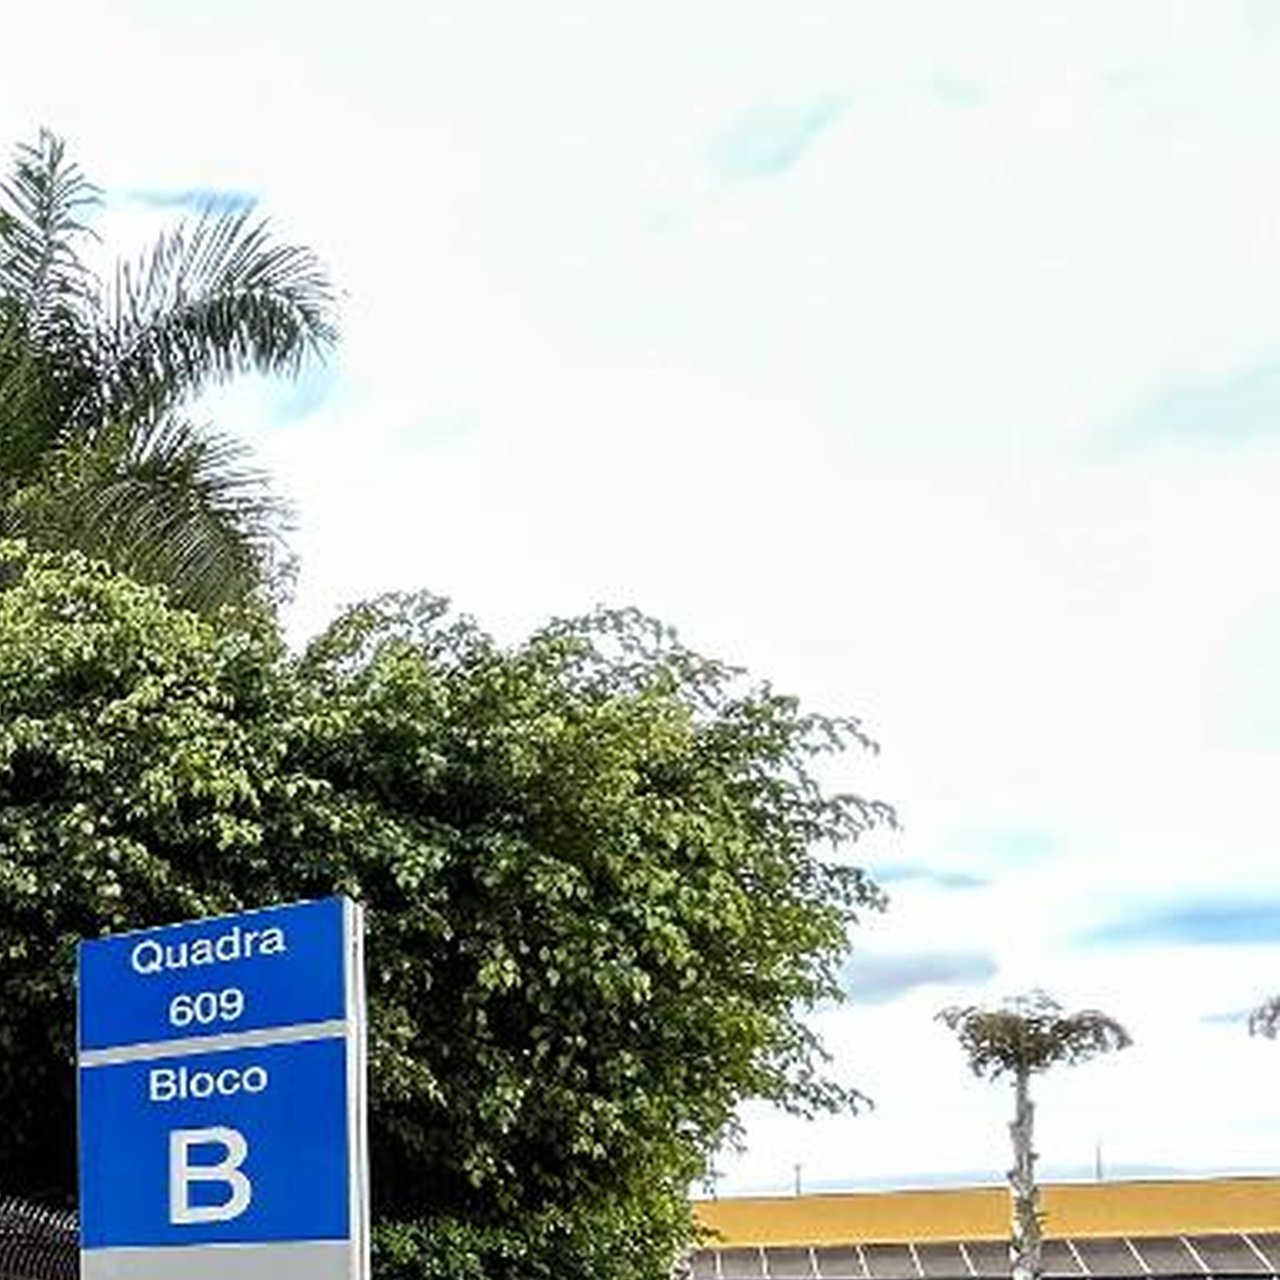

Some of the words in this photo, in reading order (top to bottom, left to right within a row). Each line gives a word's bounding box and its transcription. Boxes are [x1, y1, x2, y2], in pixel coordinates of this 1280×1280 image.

[131, 927, 287, 974] Quadra
[169, 988, 244, 1026] 609
[149, 1066, 267, 1100] Bloco
[169, 1126, 252, 1224] B
